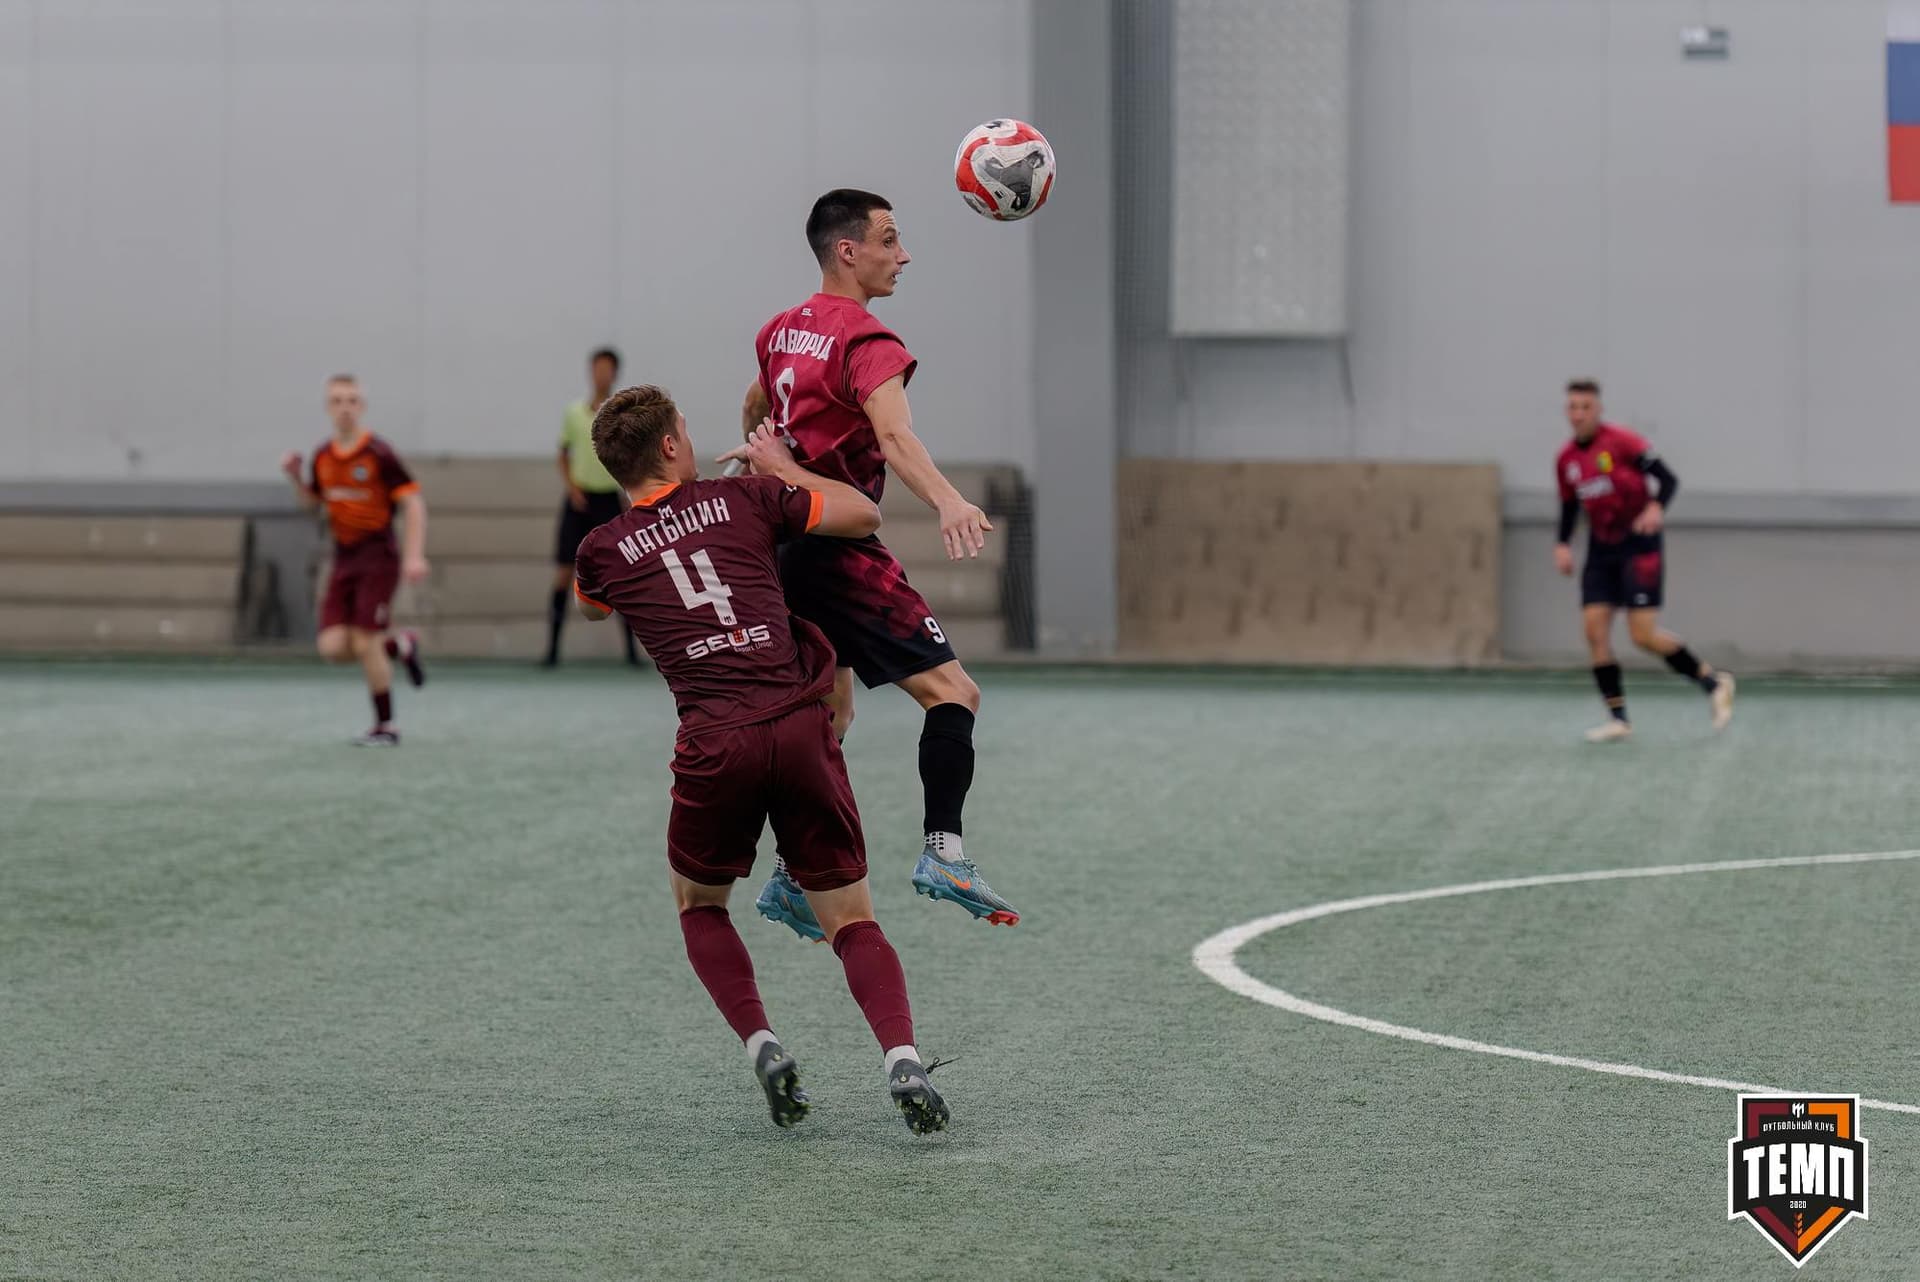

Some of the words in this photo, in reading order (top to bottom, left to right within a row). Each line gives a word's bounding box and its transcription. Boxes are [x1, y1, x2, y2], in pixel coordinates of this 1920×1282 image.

[617, 497, 731, 565] МАТЫЦИН
[660, 548, 738, 626] 4
[685, 624, 770, 660] SEUS
[924, 616, 946, 645] 9
